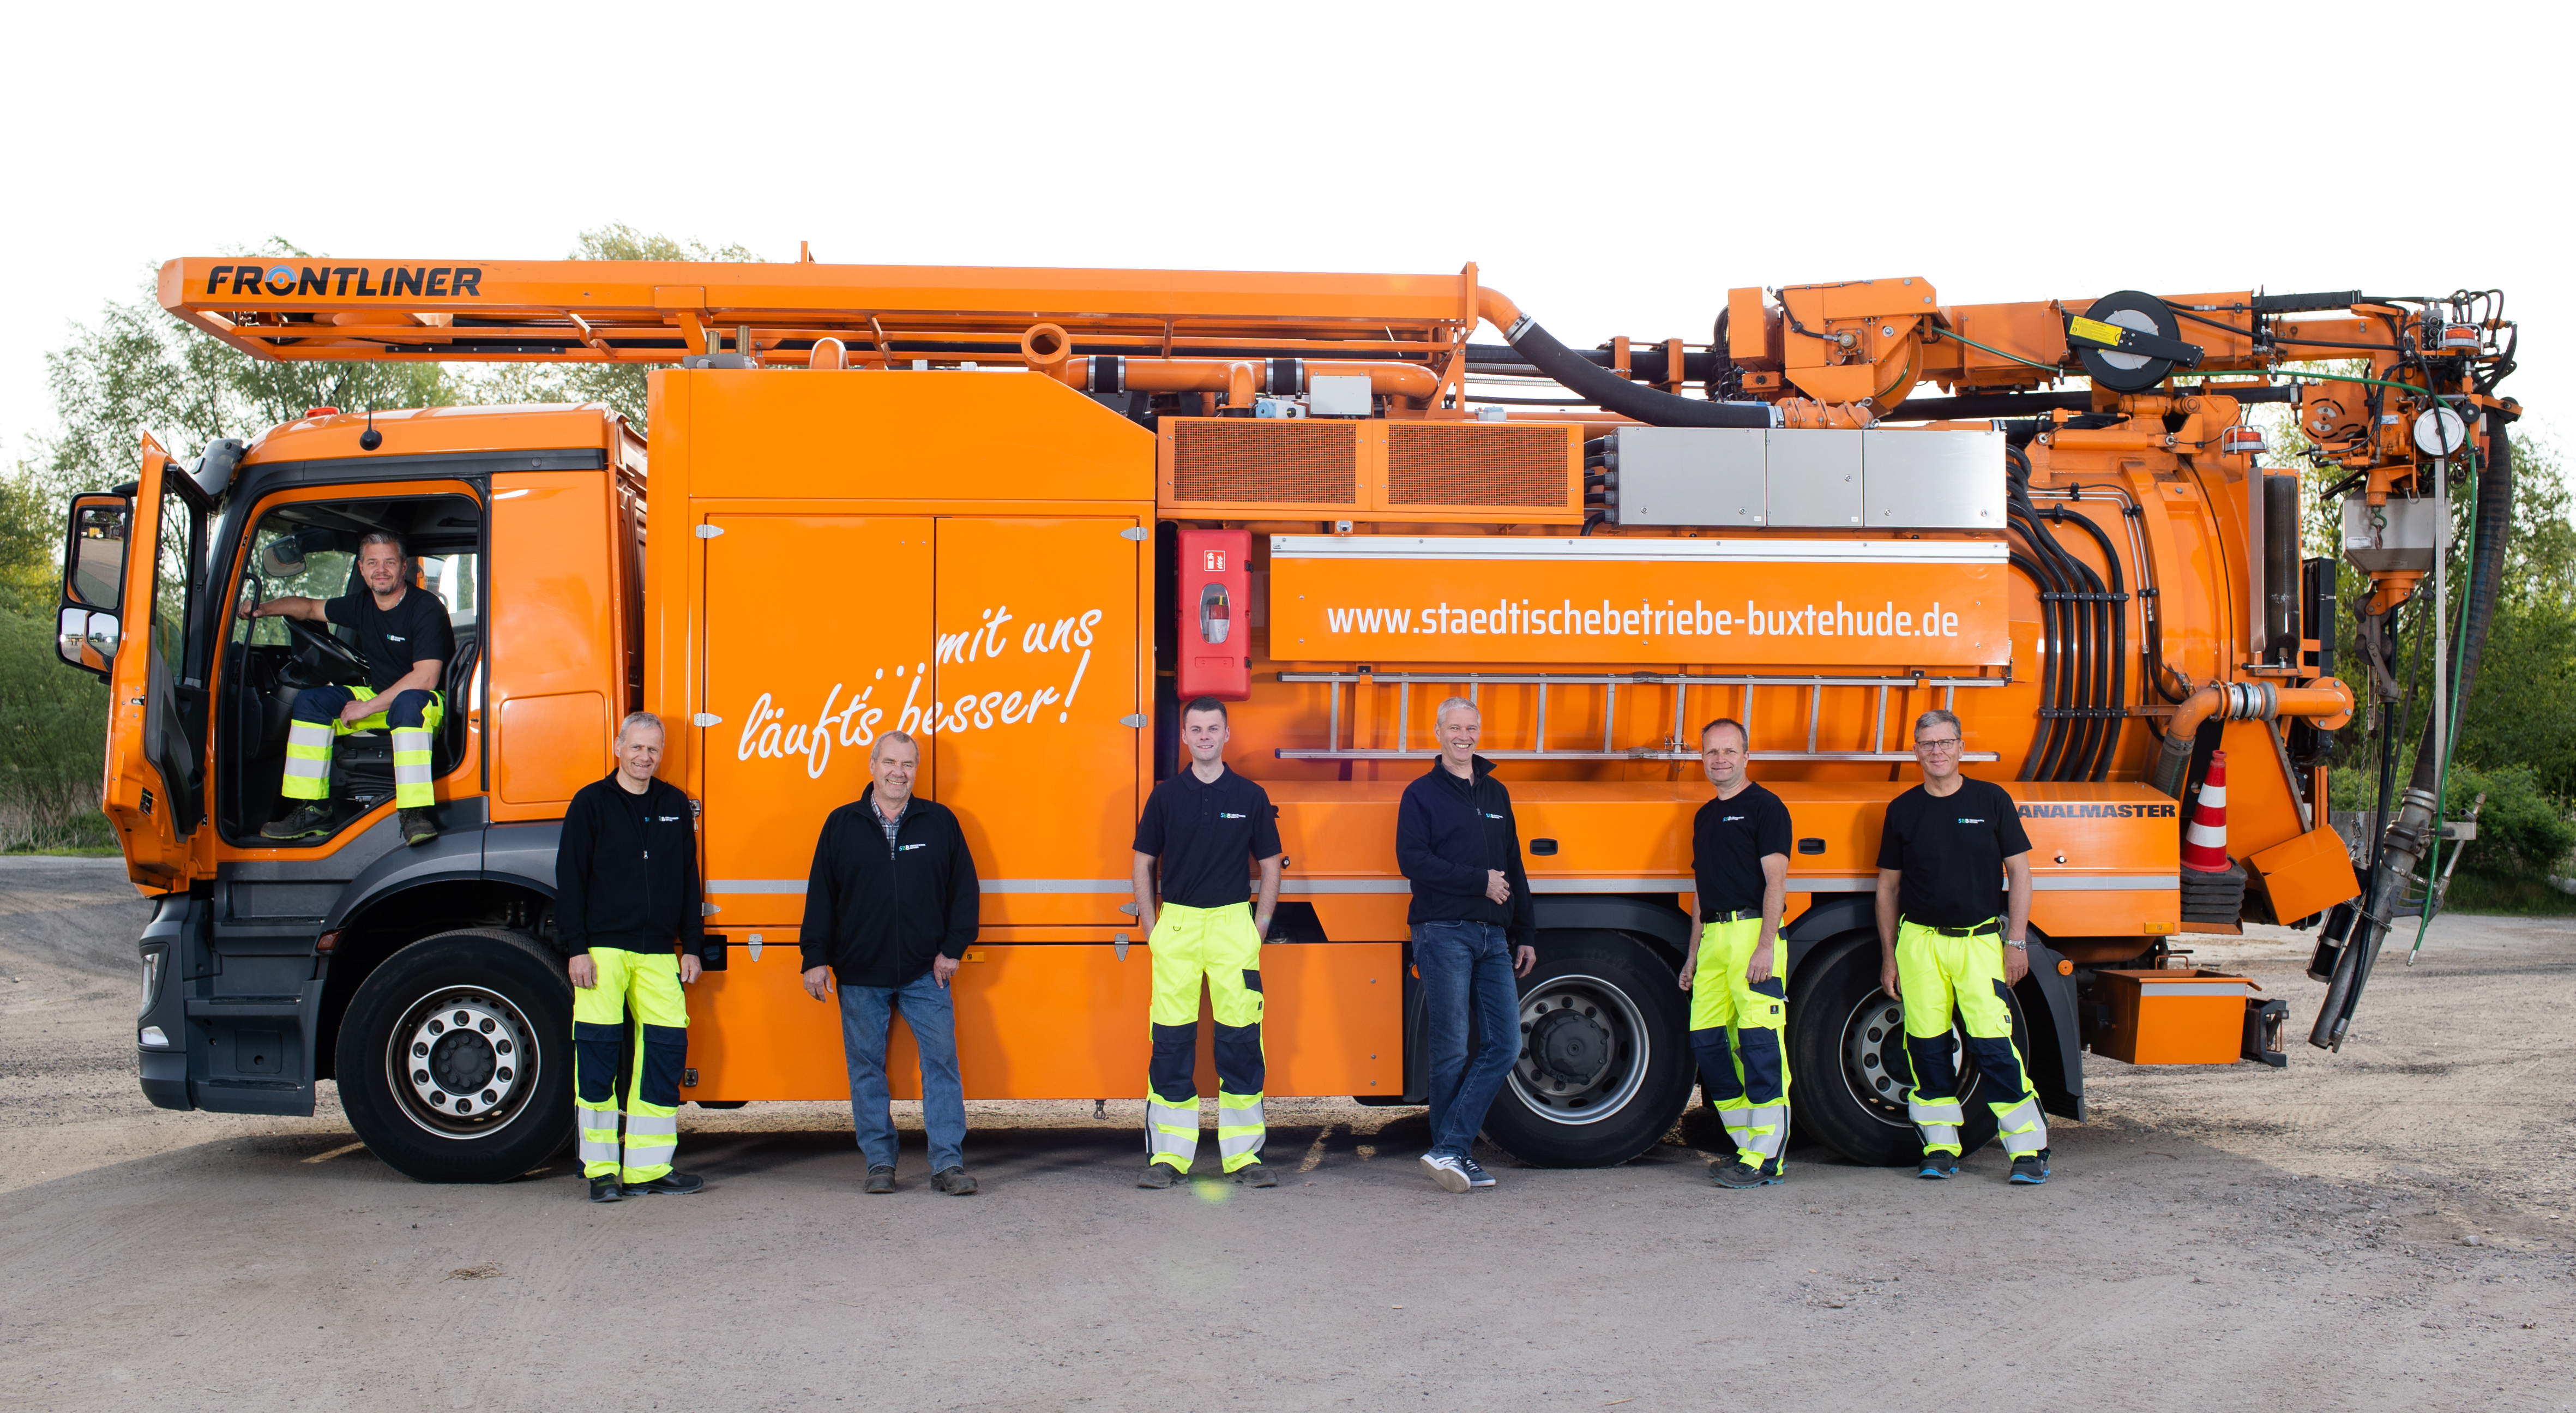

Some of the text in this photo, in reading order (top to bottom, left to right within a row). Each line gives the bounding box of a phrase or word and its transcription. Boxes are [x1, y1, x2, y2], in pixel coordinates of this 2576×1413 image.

[206, 264, 482, 297] FRONTLINER
[1022, 609, 1102, 653] uns
[1327, 598, 1958, 638] www.staedtischebetriebe-buxtehude.de
[896, 649, 1091, 736] besser!
[2017, 804, 2176, 819] ANALMASTER
